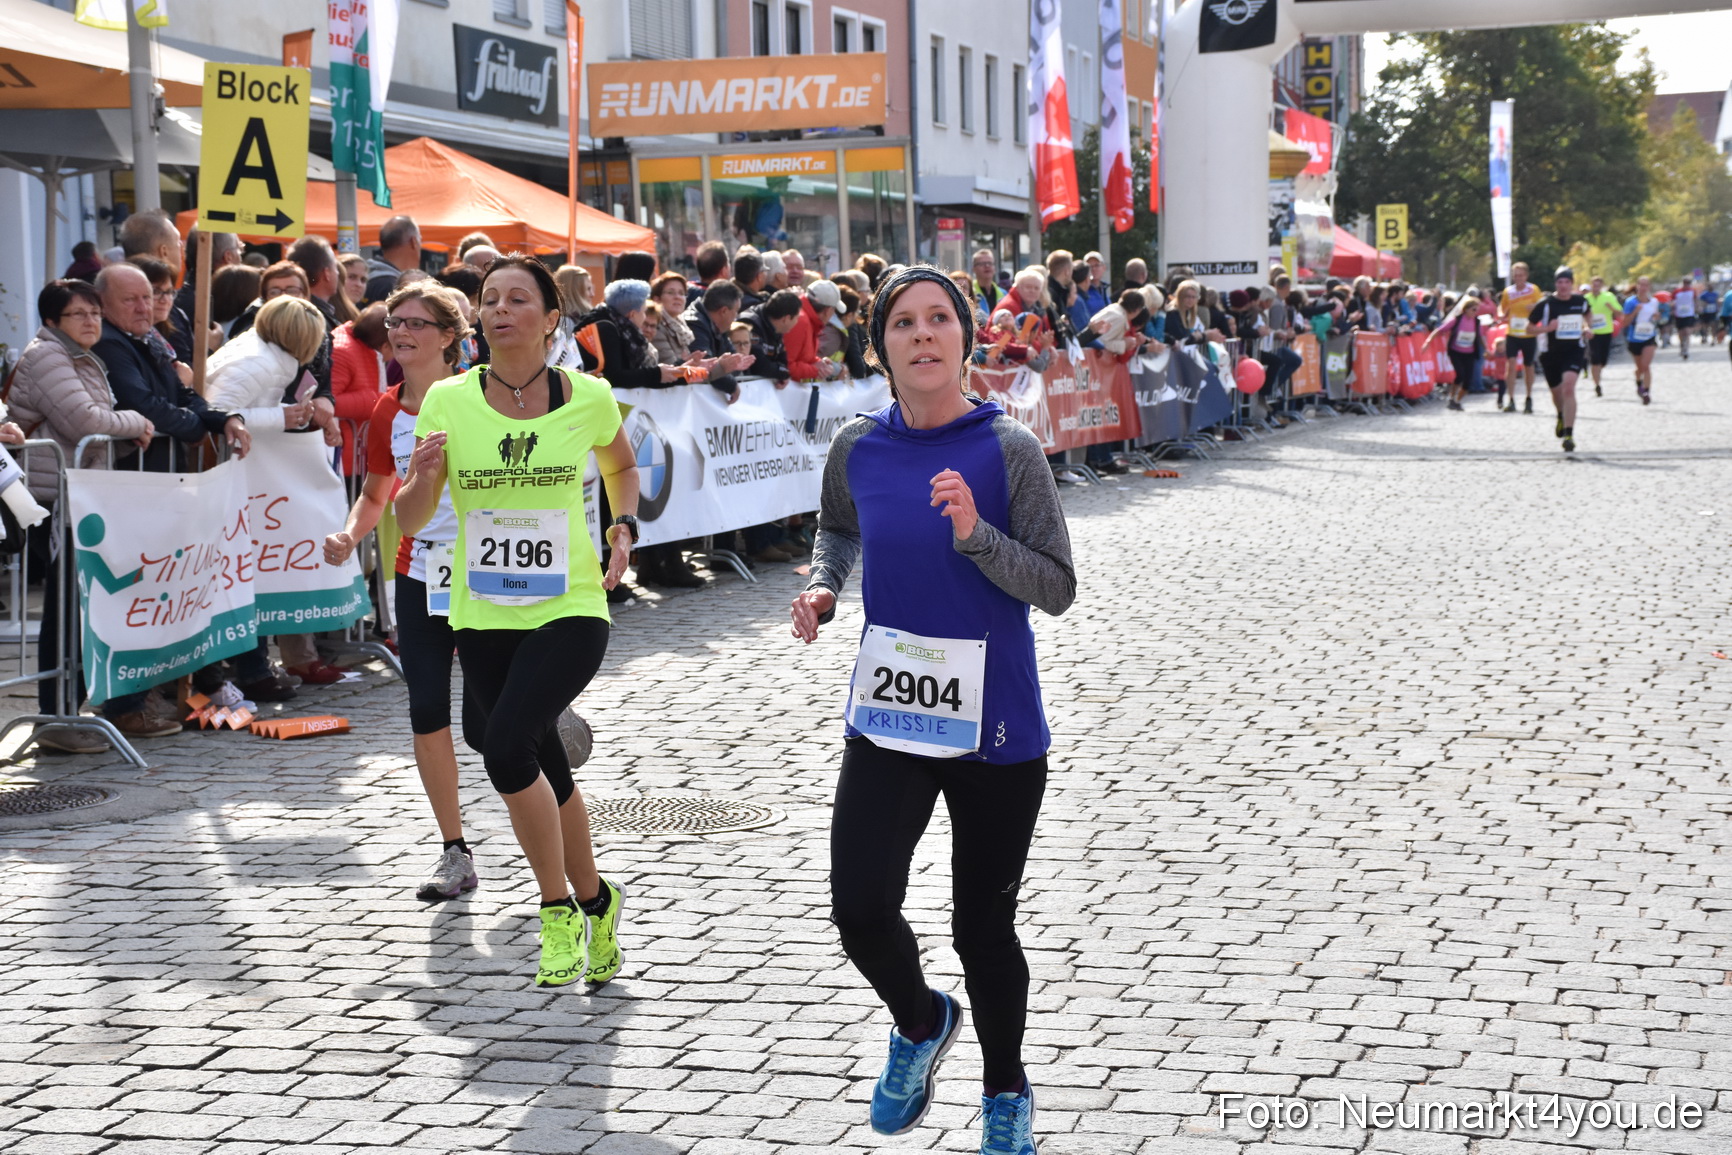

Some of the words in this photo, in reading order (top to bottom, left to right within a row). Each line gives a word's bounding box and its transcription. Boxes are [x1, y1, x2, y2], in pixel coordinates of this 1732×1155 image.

[217, 69, 300, 106] Block
[466, 38, 557, 115] frühauf
[598, 74, 872, 119] RUNMARKT.DE
[221, 116, 284, 200] A
[721, 156, 827, 175] RUNMARKT.DE
[1385, 218, 1400, 240] B
[704, 424, 744, 458] BMW
[714, 460, 750, 488] WENIGER
[503, 517, 539, 527] BOCK
[480, 537, 553, 568] 2196
[502, 578, 528, 589] Ilona
[906, 643, 946, 661] BOCK
[872, 666, 962, 712] 2904
[867, 710, 948, 735] KRISSIE
